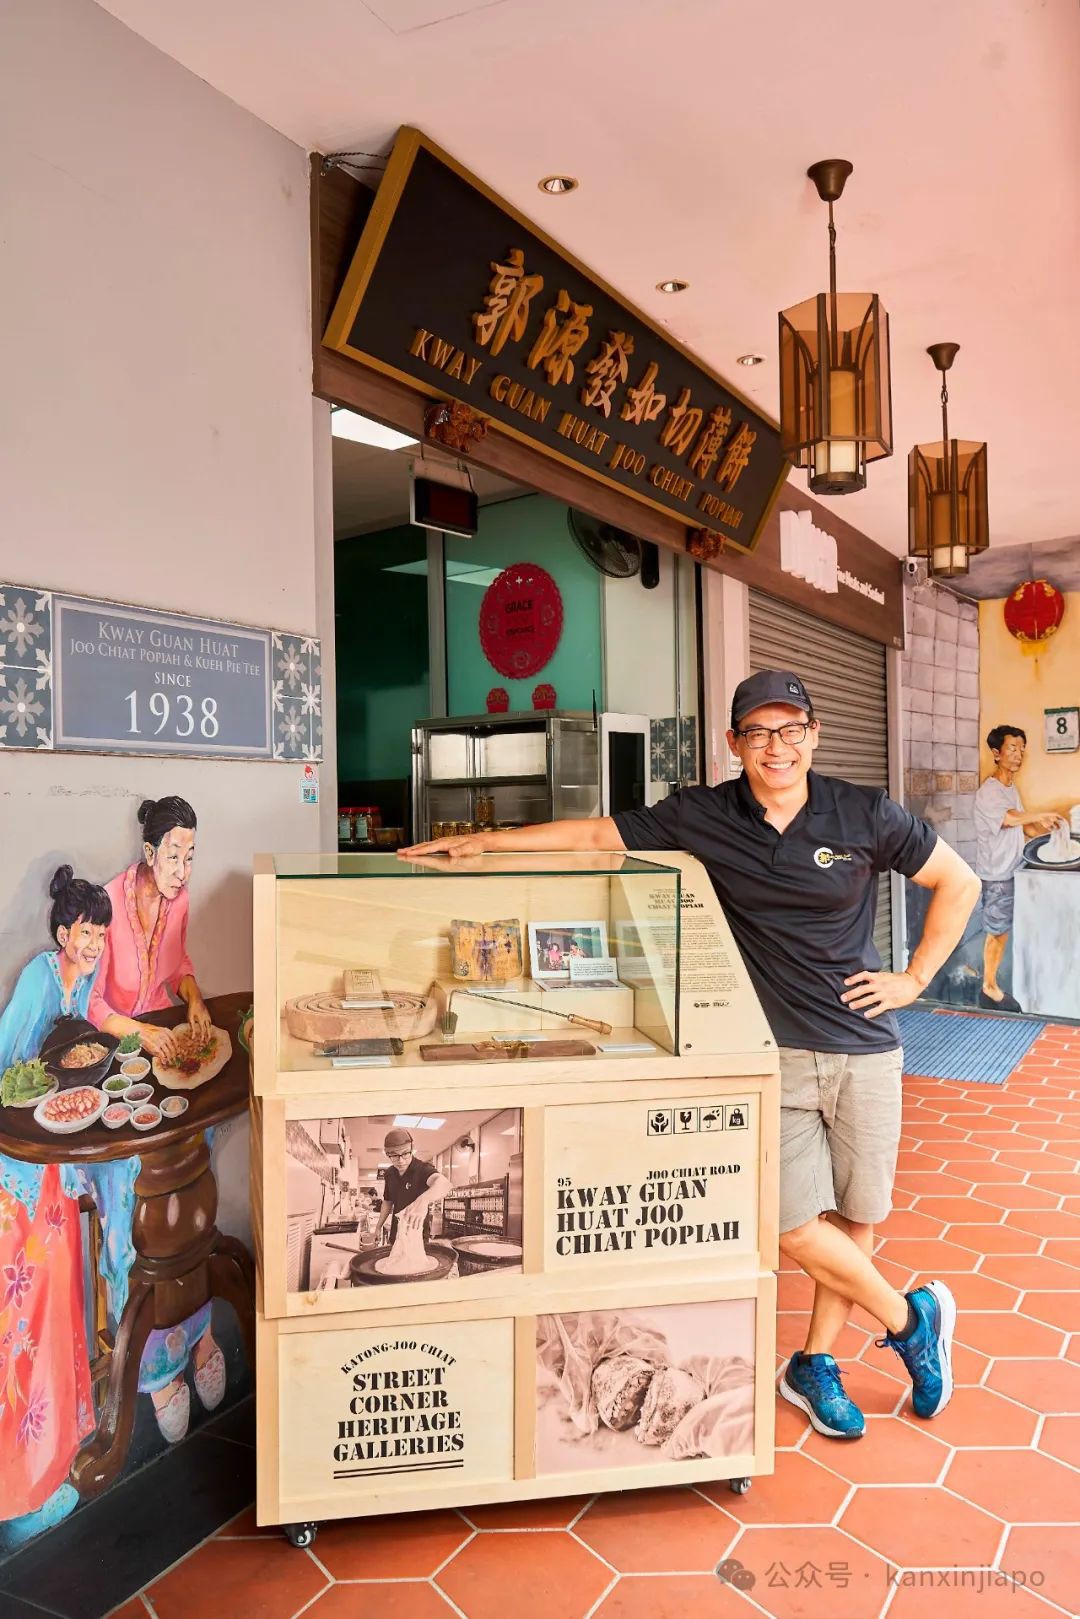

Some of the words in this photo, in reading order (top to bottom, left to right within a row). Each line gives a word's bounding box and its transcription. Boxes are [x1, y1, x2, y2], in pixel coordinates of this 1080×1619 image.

[411, 328, 483, 385] KWAY
[491, 375, 552, 424] GUAN
[559, 412, 610, 455] HUAT
[611, 442, 646, 476] JOO
[652, 465, 696, 502] CHIAT
[701, 493, 745, 529] POPIAH
[98, 621, 144, 644] KWAY
[150, 630, 193, 651] GUAN
[200, 637, 239, 659] HUAT
[70, 638, 95, 655] JOO
[98, 640, 137, 661] CHIAT
[140, 648, 181, 667] POPIAH
[184, 654, 193, 668] &
[195, 656, 224, 672] KUEH
[226, 660, 241, 674] PIE
[243, 663, 260, 676] TEE
[154, 671, 192, 688] SINCE
[124, 689, 220, 738] 1938
[1056, 716, 1068, 735] 8
[732, 1116, 741, 1126] kg
[557, 1177, 572, 1187] 95
[646, 1169, 669, 1181] JOO
[671, 1166, 707, 1179] CHIAT
[710, 1164, 741, 1176] ROAD
[557, 1184, 632, 1210] KWAY
[639, 1178, 708, 1203] GUAN
[556, 1207, 629, 1233] HUAT
[635, 1203, 684, 1226] JOO
[556, 1230, 637, 1256] CHIAT
[644, 1220, 740, 1248] POPIAH
[340, 1340, 417, 1375] KATONG-JOO
[420, 1343, 457, 1366] CHIAT
[352, 1367, 446, 1392] STREET
[349, 1389, 449, 1415] CORNER
[337, 1411, 461, 1439] HERITAGE
[333, 1433, 464, 1462] GALLERIES
